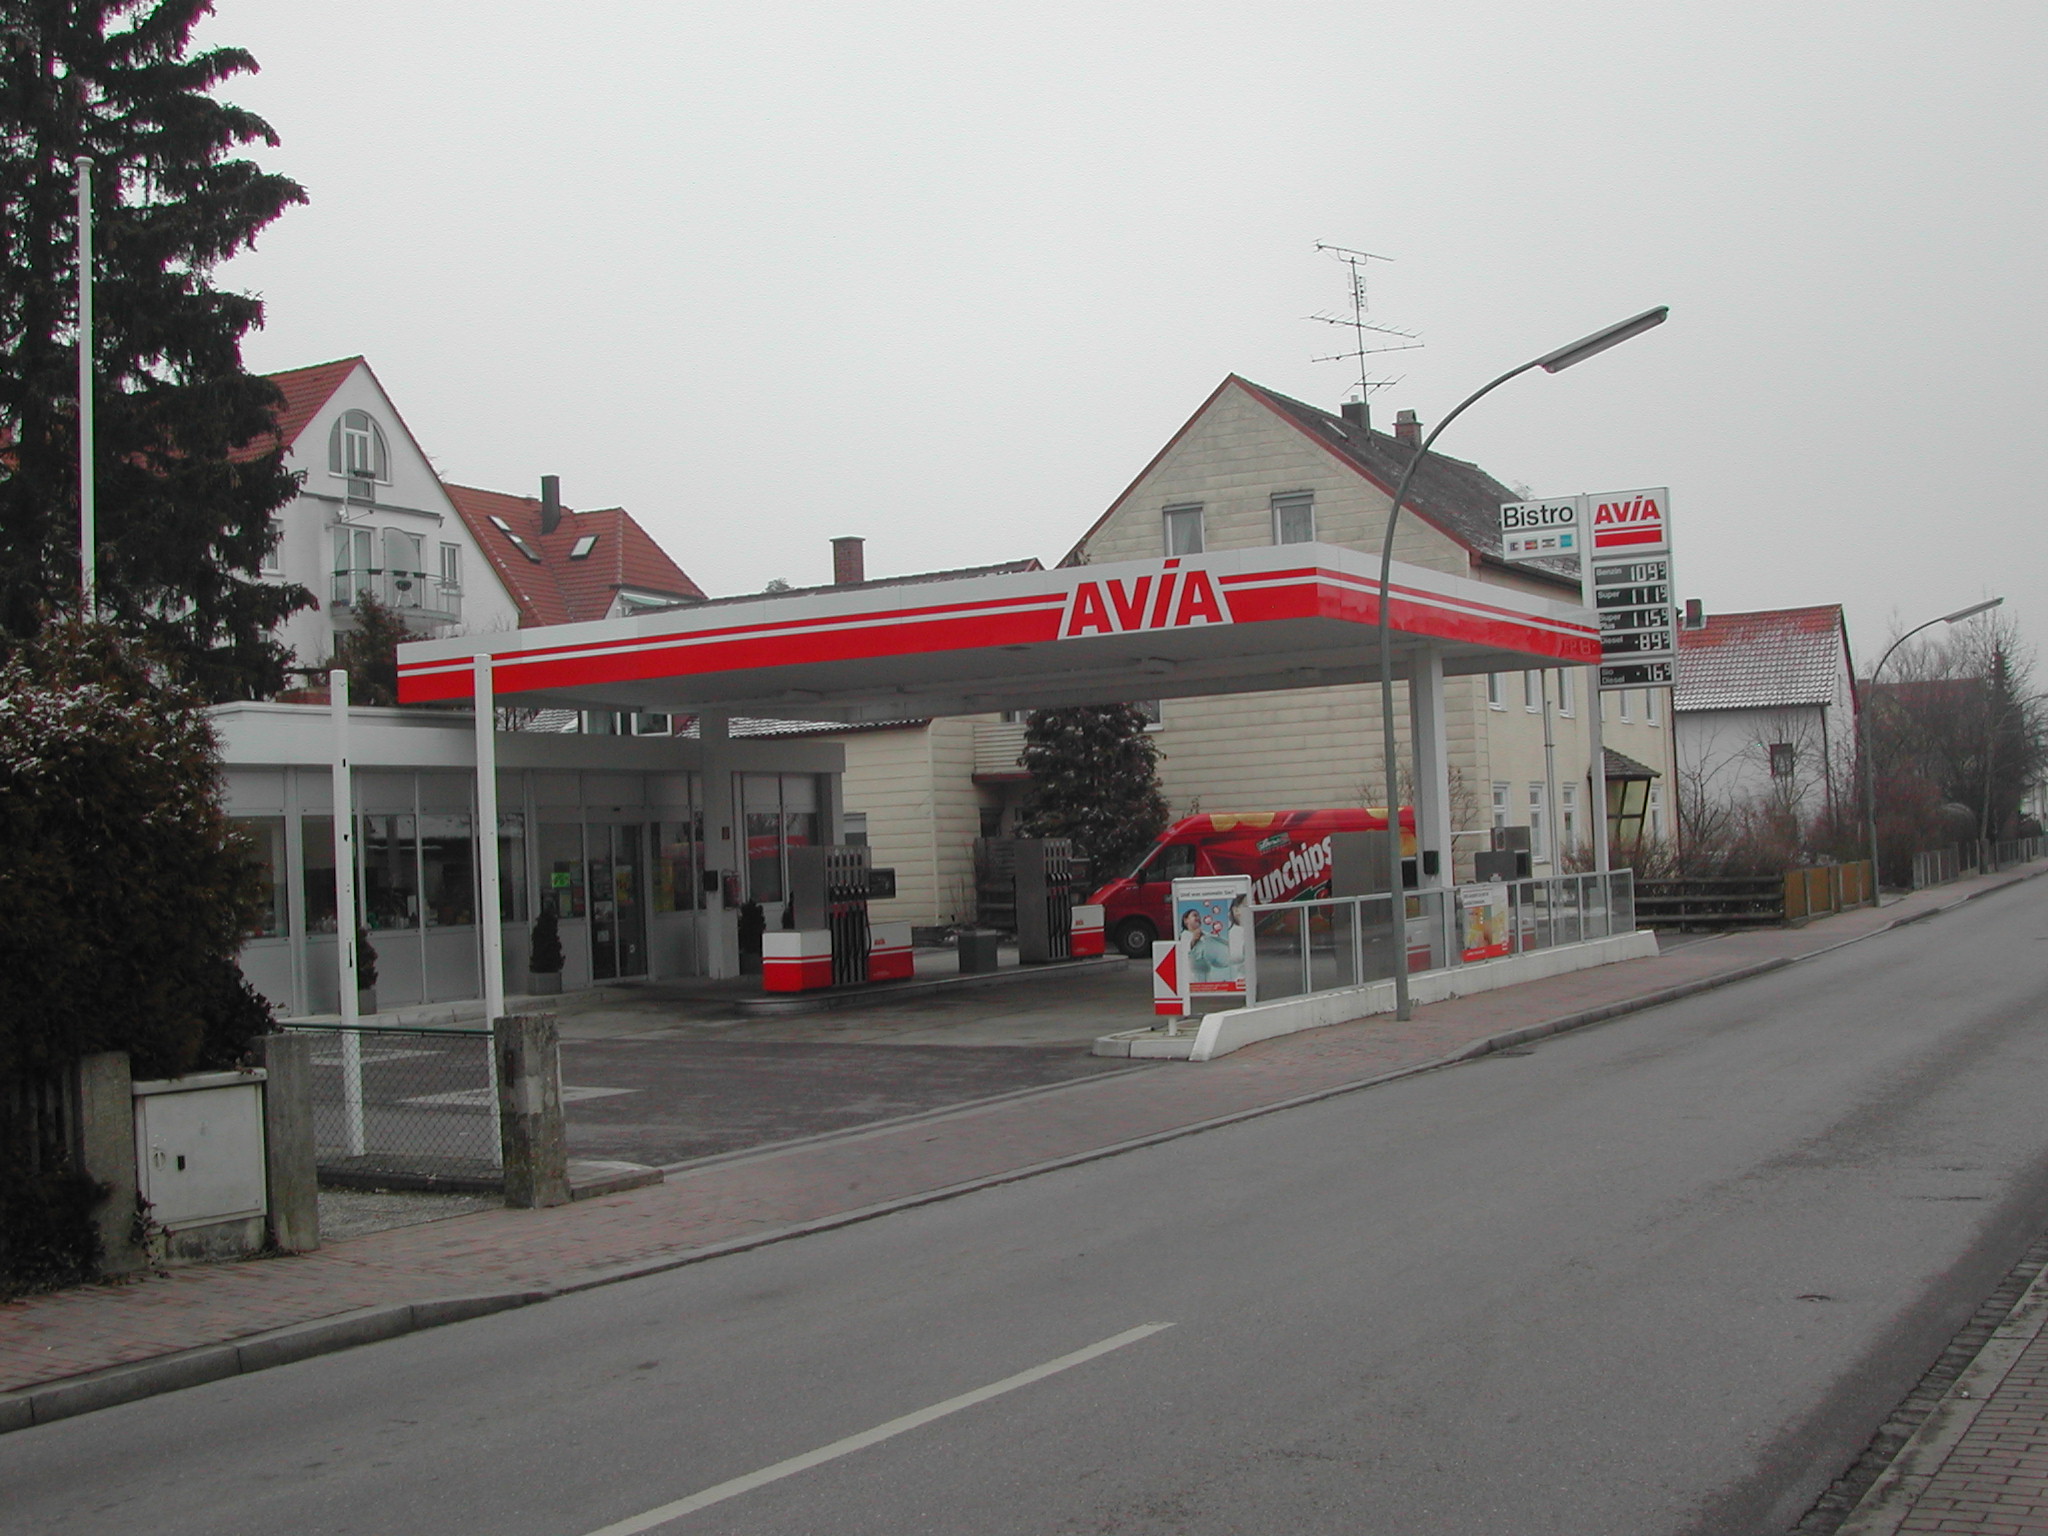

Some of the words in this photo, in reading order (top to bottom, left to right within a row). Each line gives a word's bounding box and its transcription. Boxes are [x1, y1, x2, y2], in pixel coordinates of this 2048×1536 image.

[1503, 504, 1574, 529] Bistro
[1594, 495, 1661, 525] AVIA
[1596, 567, 1623, 577] Benzin
[1066, 558, 1224, 637] AVIA
[1597, 590, 1621, 600] Super
[1601, 675, 1626, 685] Diesel
